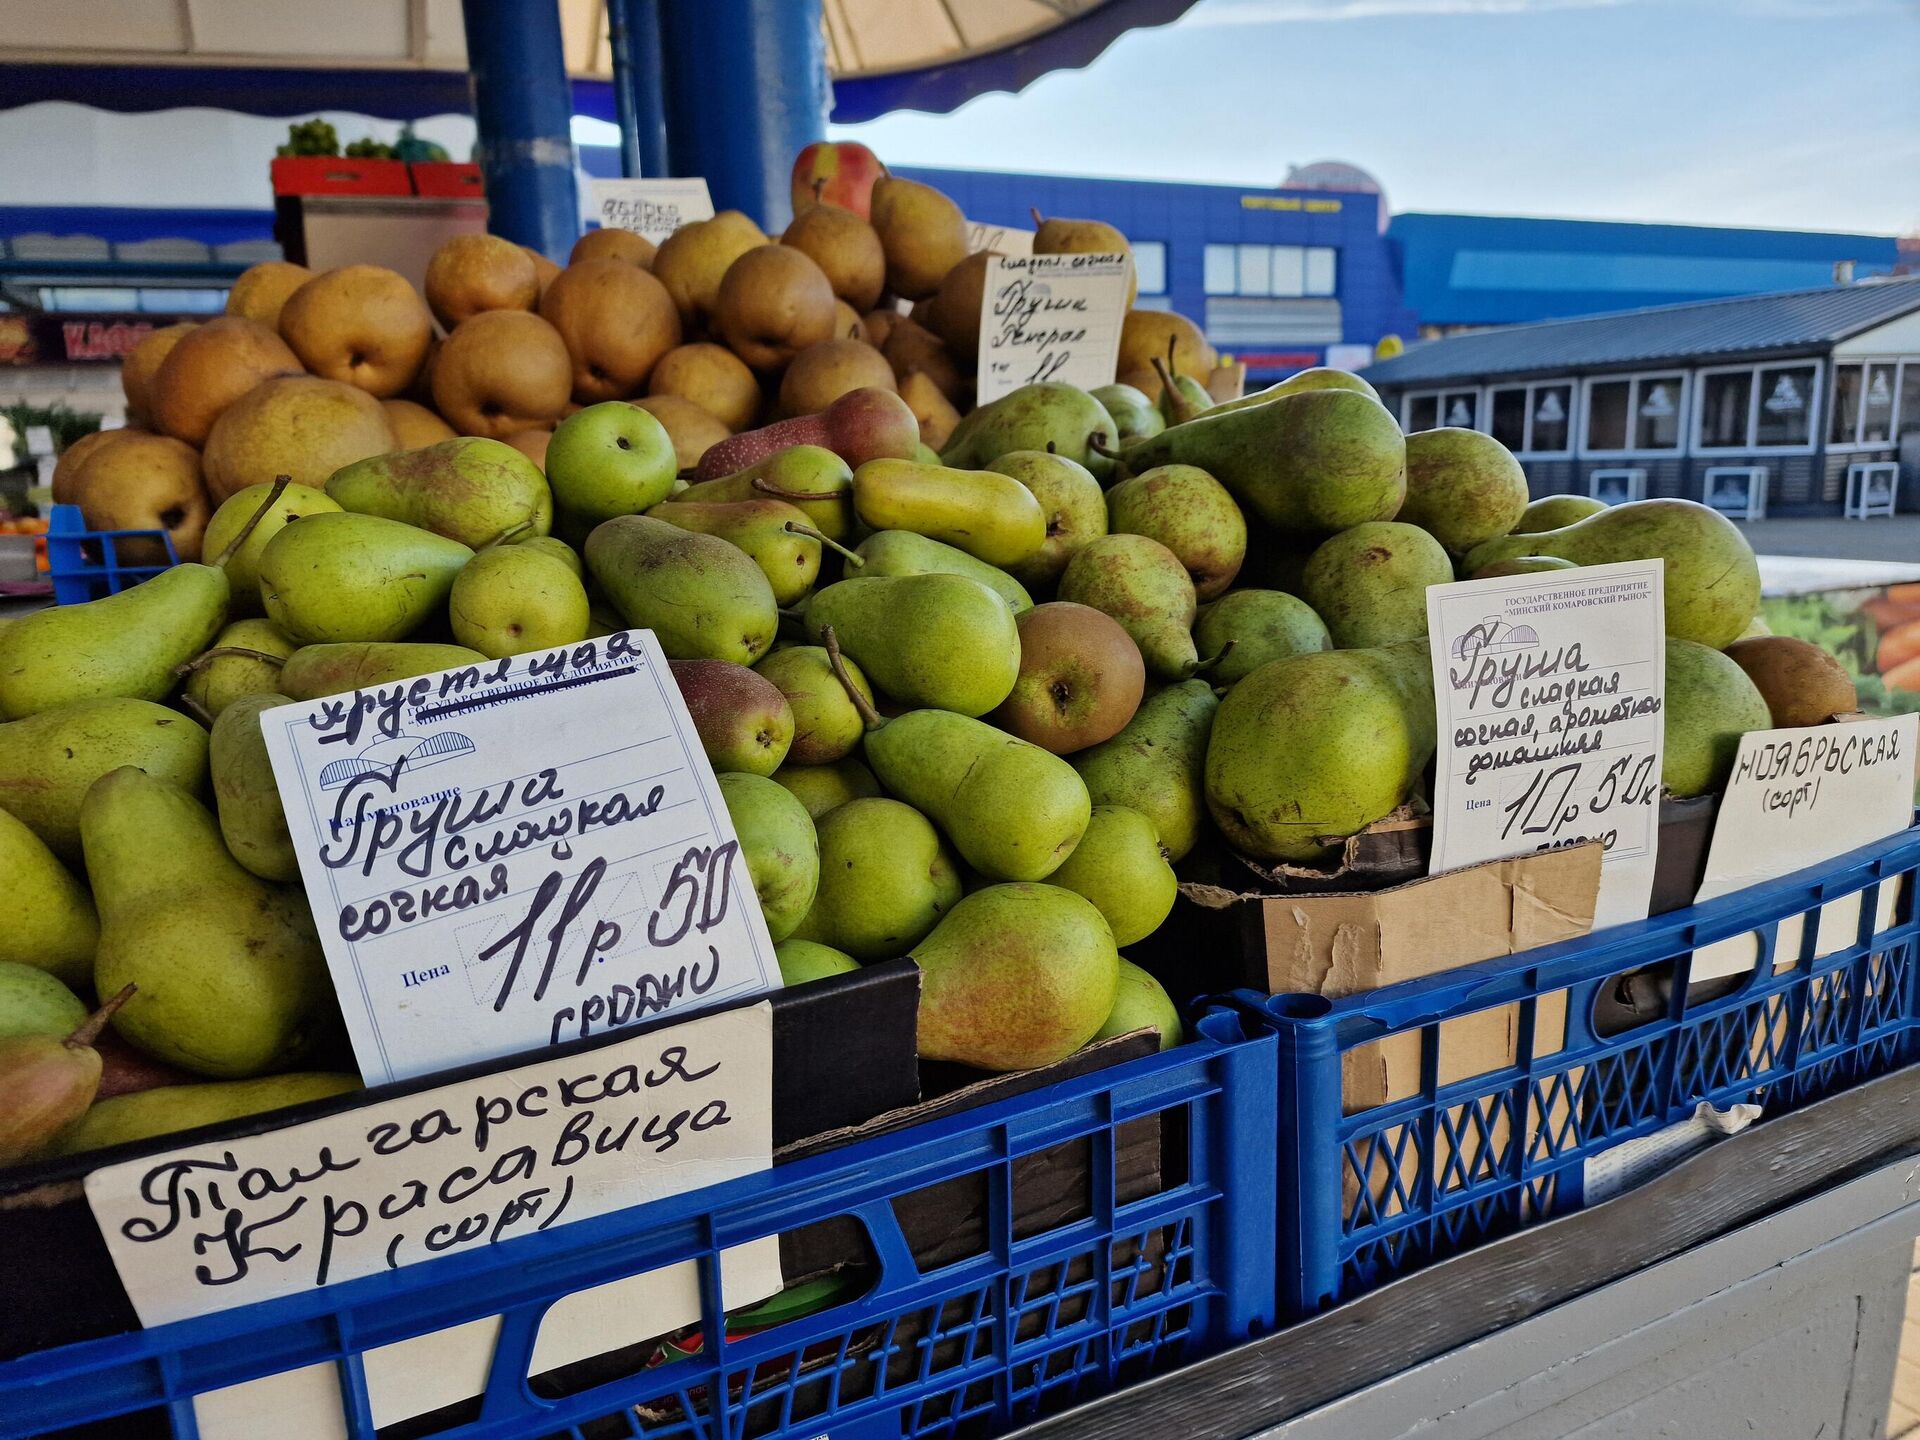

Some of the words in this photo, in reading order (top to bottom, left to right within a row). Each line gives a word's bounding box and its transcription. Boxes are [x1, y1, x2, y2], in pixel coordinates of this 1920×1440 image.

[994, 280, 1088, 326] Груша
[1505, 588, 1586, 606] ГОСУДАРСТВЕННОЕ
[1588, 581, 1649, 595] ПРЕДПРИЯТИЕ
[1552, 594, 1616, 611] КОМАРОВСКИЙ
[1450, 620, 1590, 710] Груша
[1521, 672, 1620, 717] сладкая
[1735, 729, 1901, 785] НОЯБРЬСКАЯ
[318, 754, 564, 878] Груша
[1465, 799, 1492, 811] Цена
[1762, 776, 1821, 819] (сорт)
[445, 785, 666, 870] сладкая
[401, 964, 452, 989] Цена
